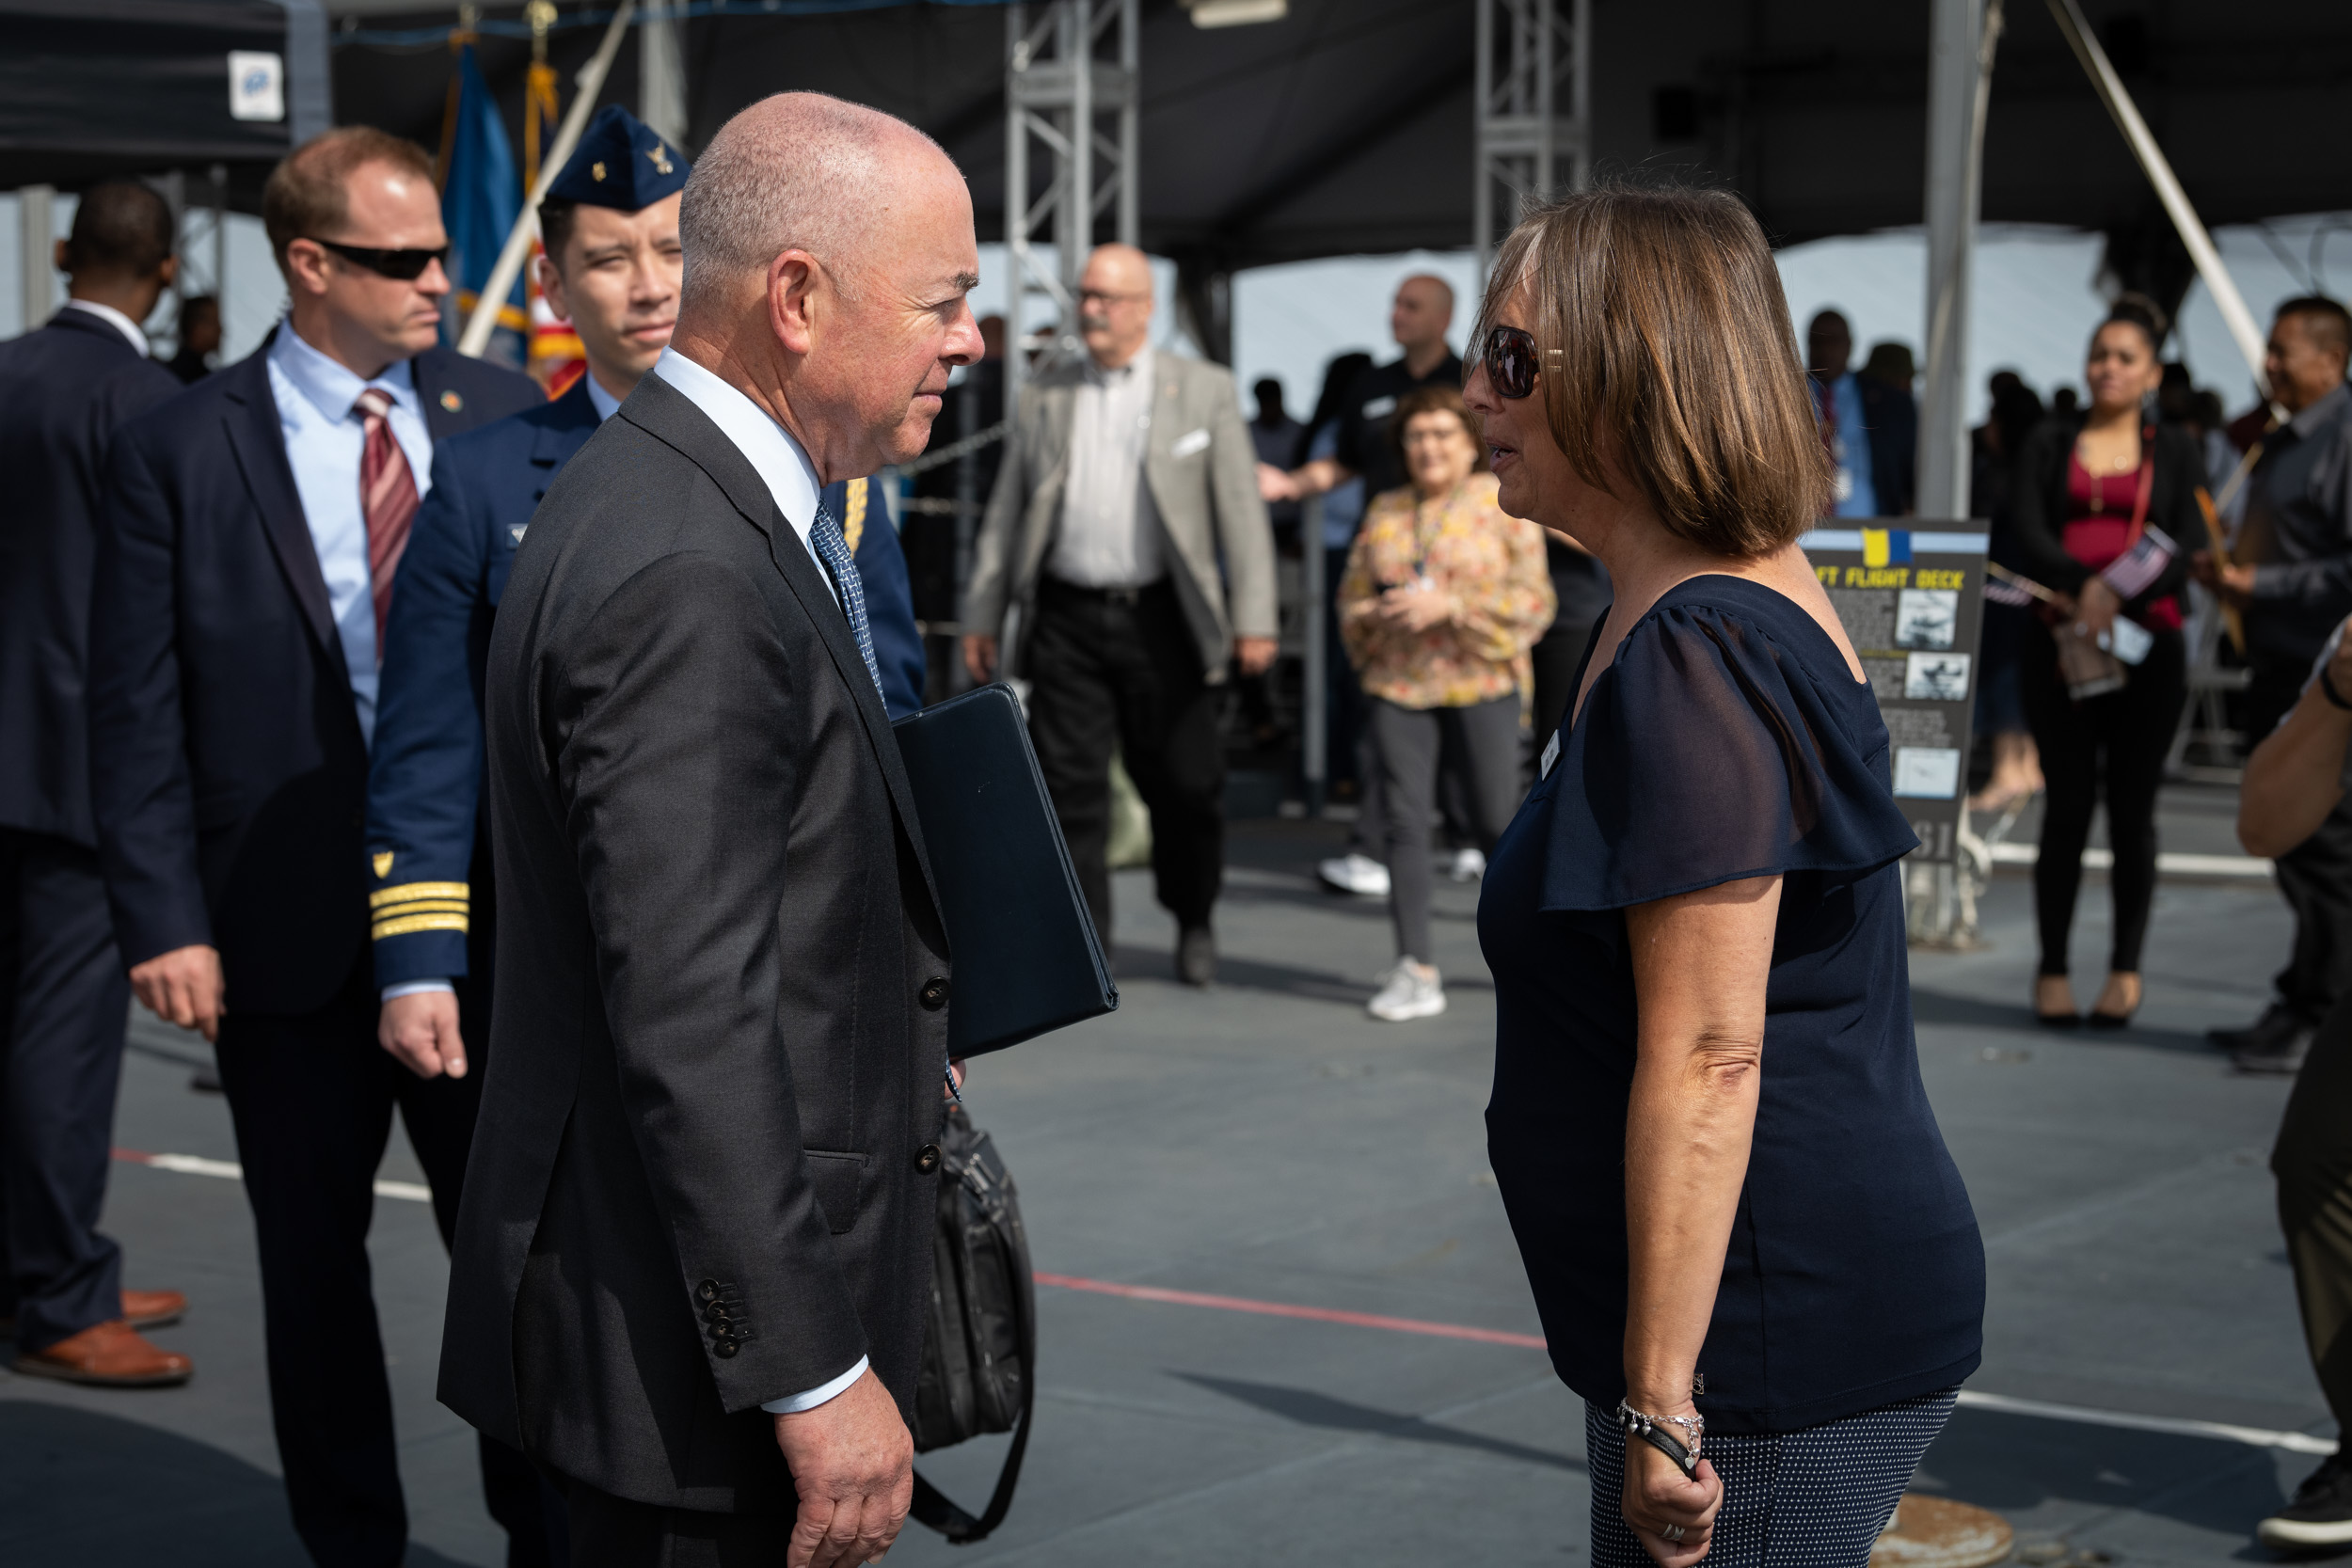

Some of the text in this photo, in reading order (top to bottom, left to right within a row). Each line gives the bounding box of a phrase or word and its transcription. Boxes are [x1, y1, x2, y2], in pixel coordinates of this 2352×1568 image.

[1815, 566, 1965, 590] FT FLIGHT DECK
